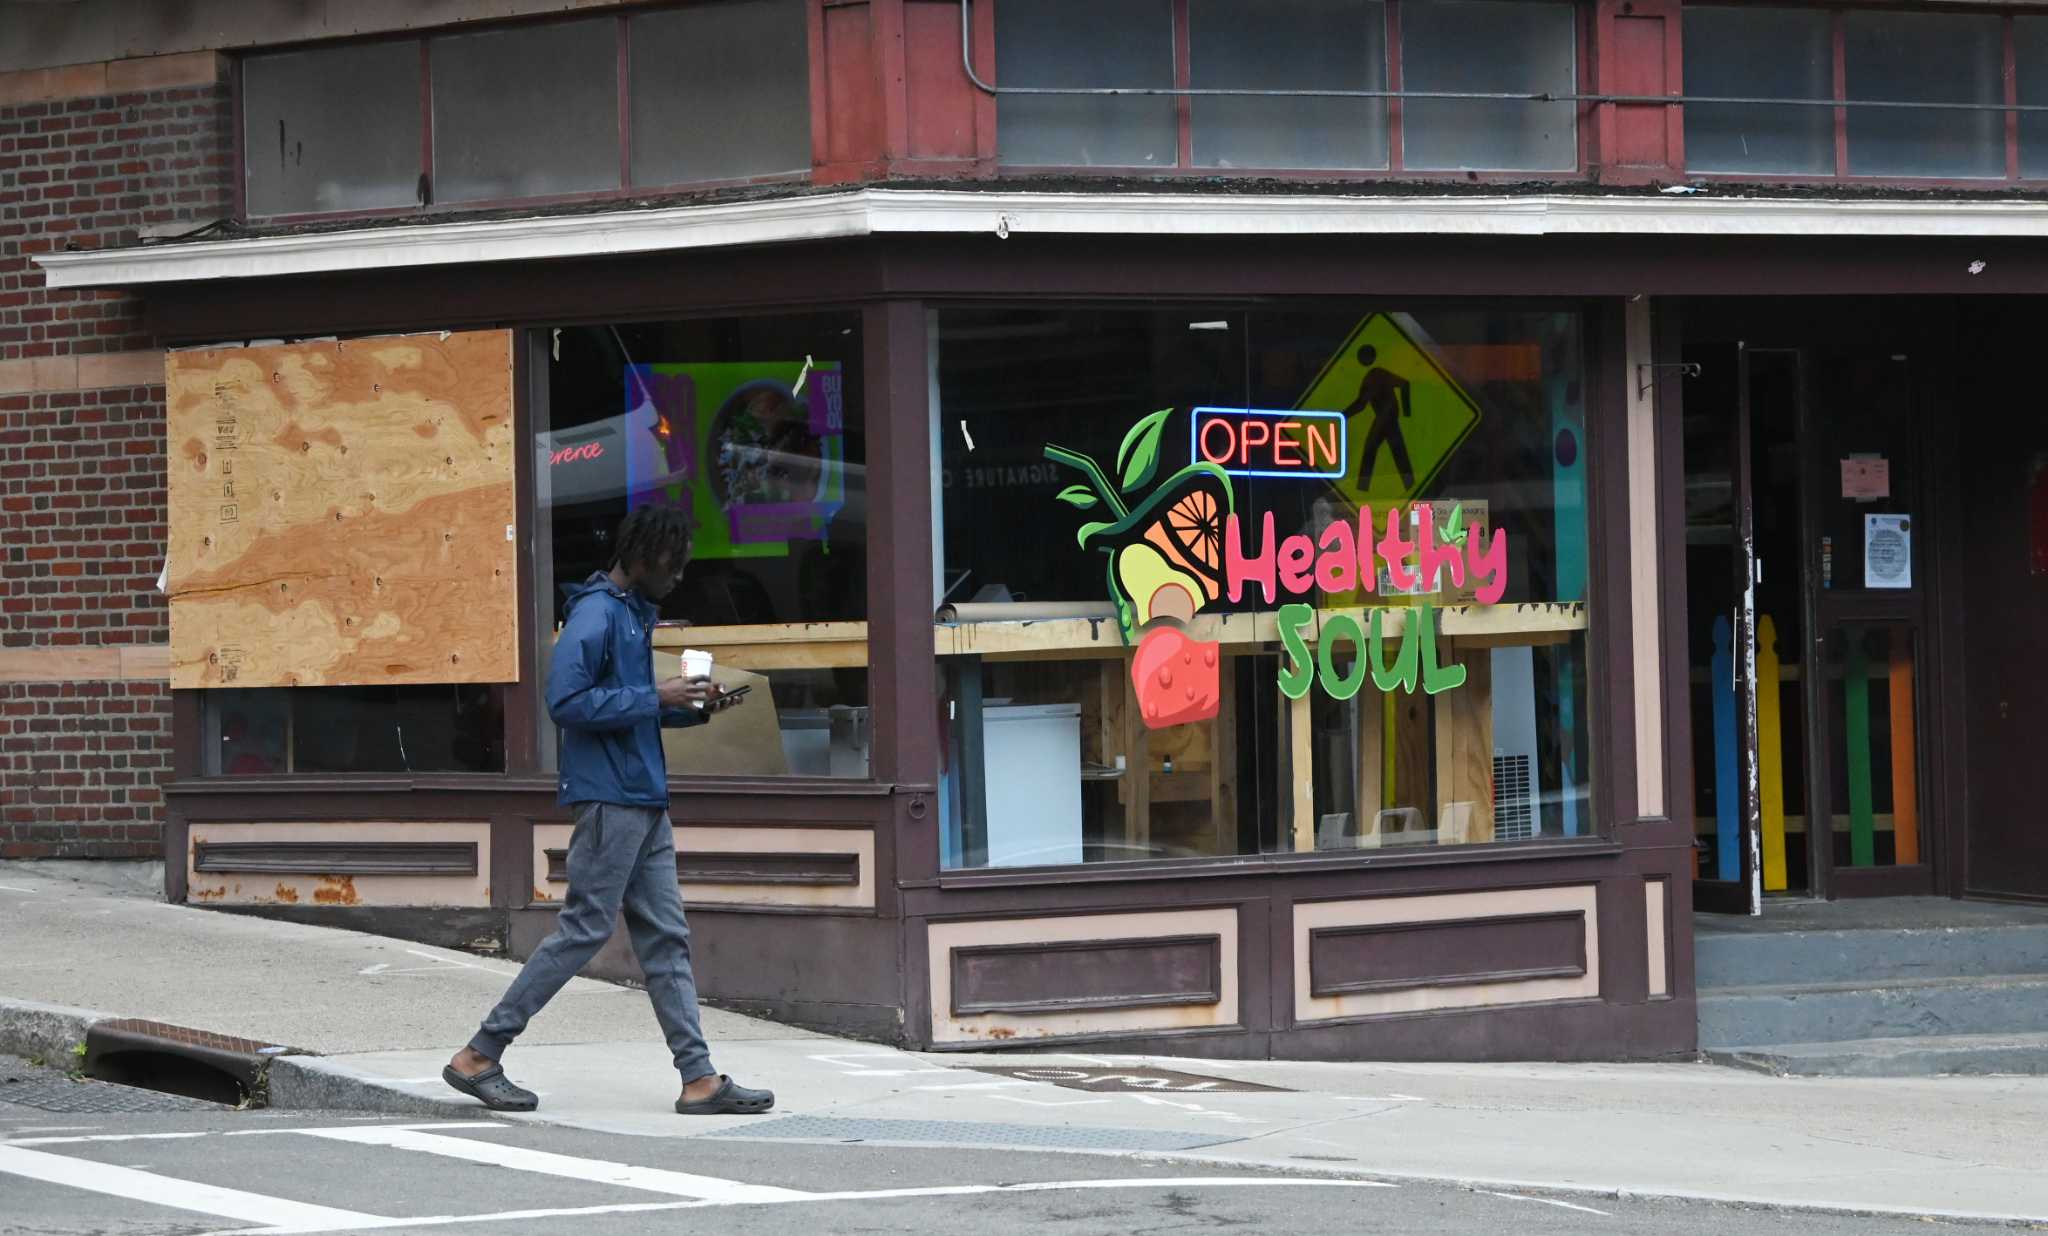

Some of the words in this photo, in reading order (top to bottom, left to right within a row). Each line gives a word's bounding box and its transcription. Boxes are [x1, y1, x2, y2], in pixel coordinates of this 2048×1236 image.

[1200, 418, 1337, 466] OPEN
[1225, 503, 1507, 604] Healthy
[1277, 602, 1467, 700] SOUL
